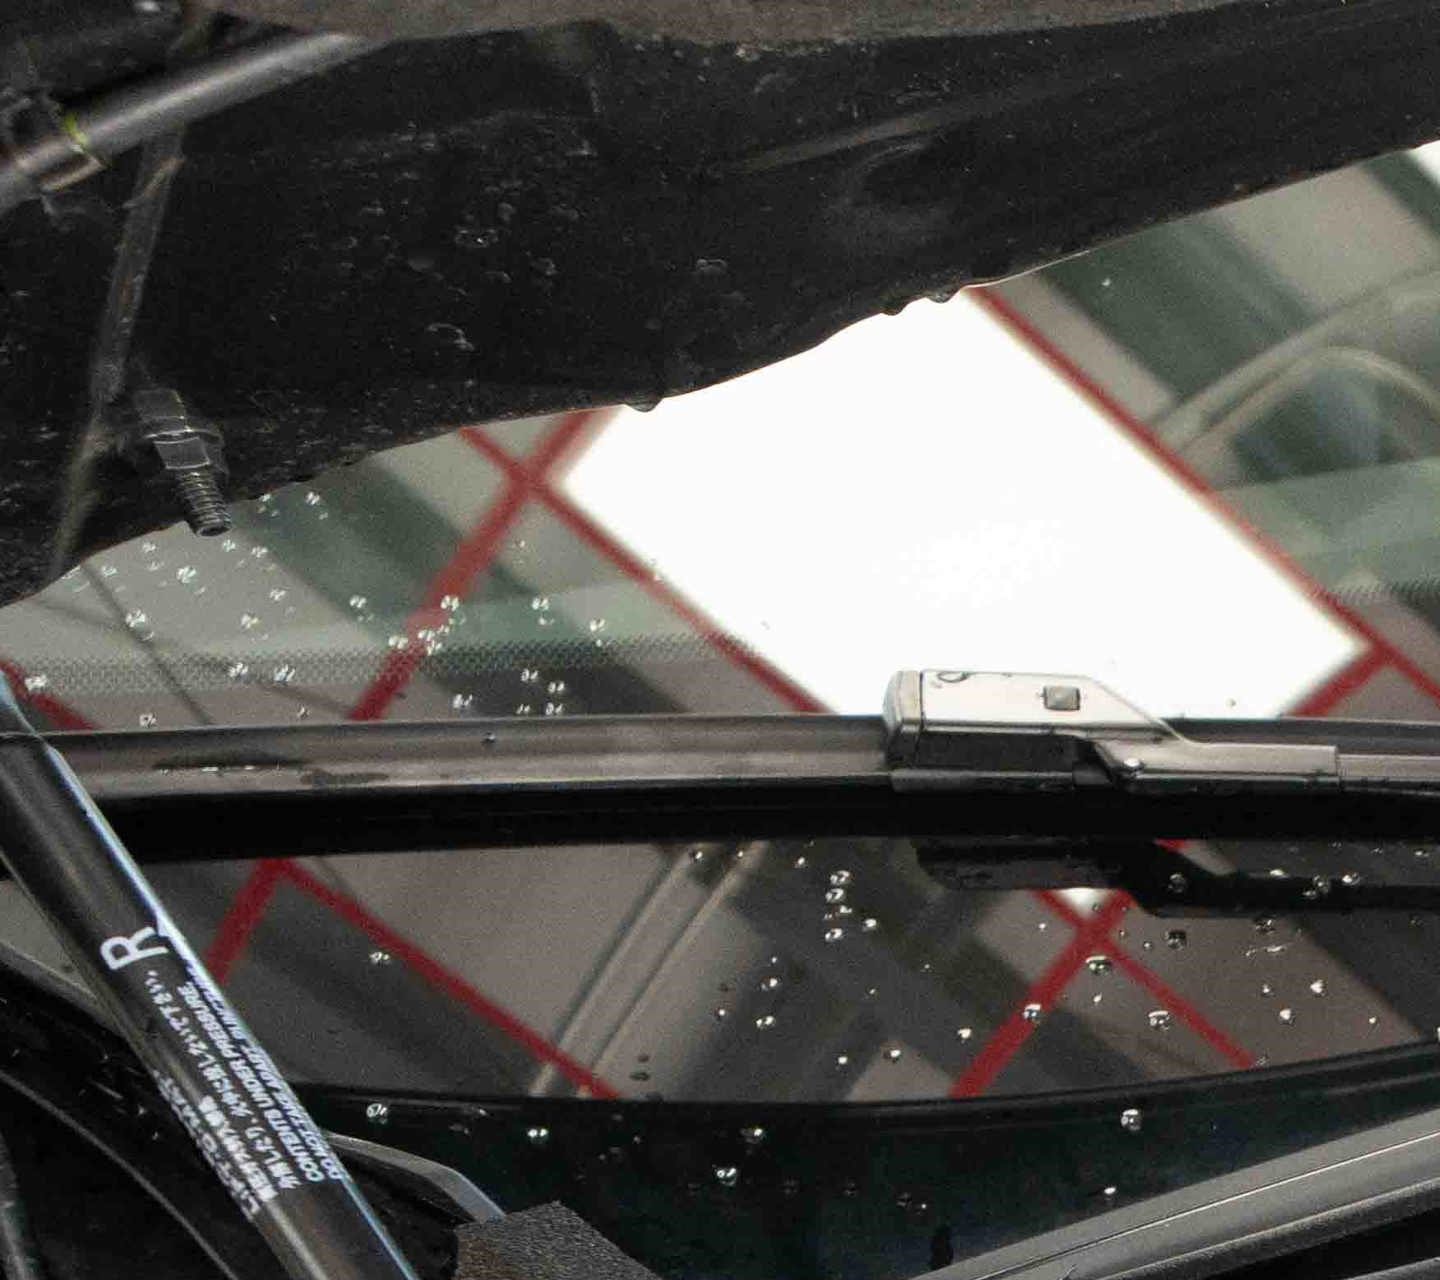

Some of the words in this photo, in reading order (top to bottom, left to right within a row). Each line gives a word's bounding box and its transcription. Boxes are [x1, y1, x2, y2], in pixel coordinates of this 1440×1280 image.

[100, 924, 168, 970] R
[228, 1058, 274, 1109] UNDER
[263, 1106, 326, 1182] CONTENTS
